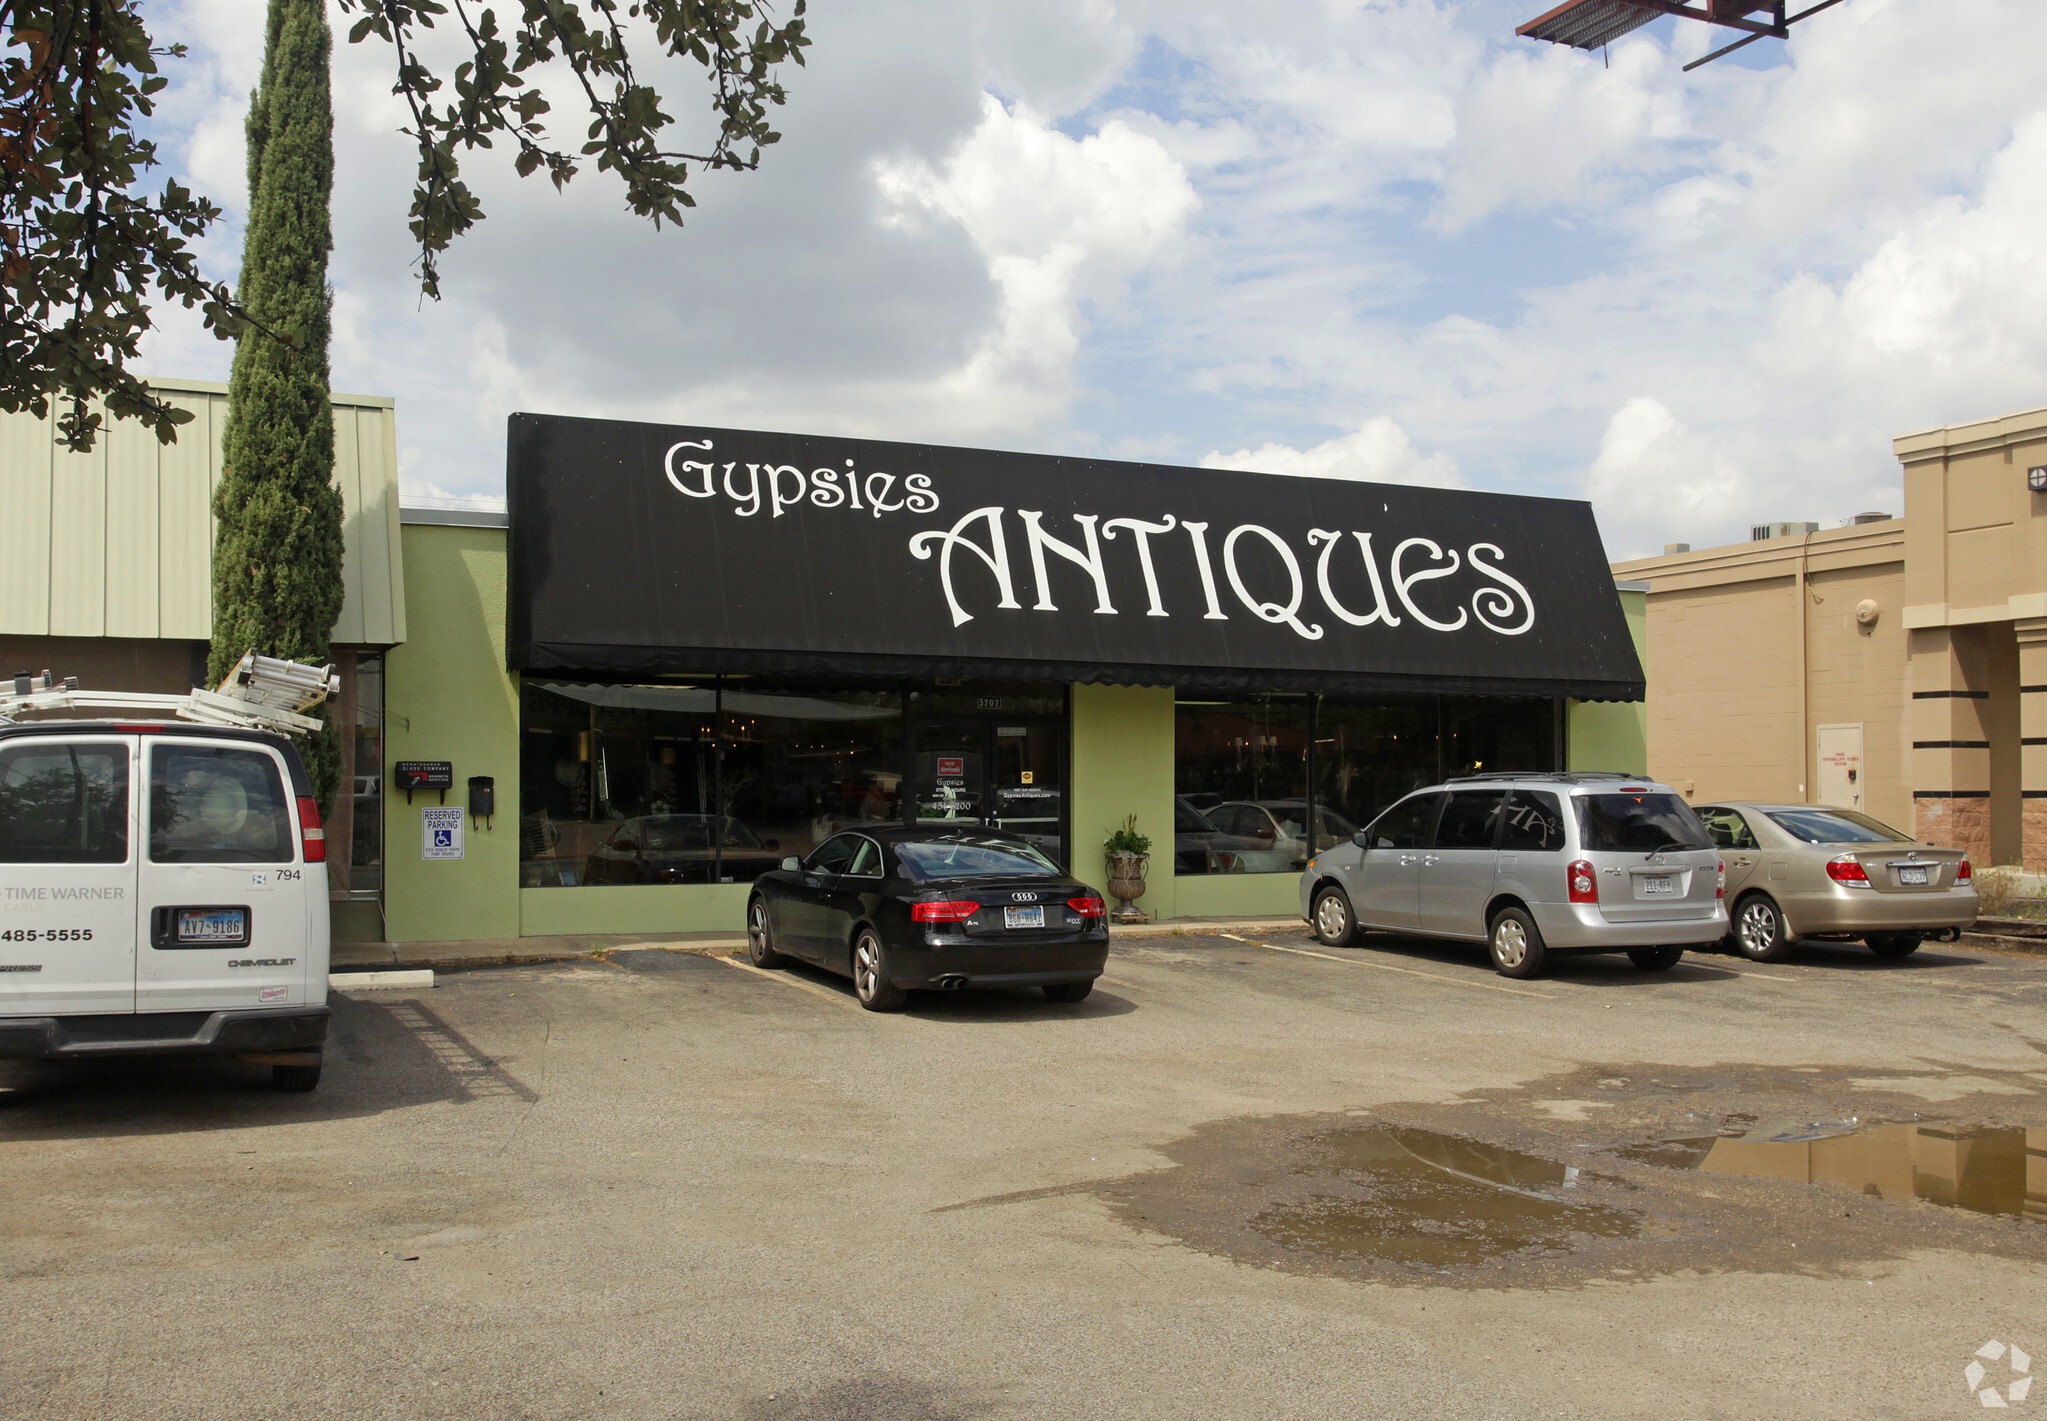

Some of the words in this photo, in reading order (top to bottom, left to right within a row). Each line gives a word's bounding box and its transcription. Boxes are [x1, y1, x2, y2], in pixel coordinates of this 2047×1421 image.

[665, 440, 939, 518] Gypsies
[909, 507, 1534, 640] ANTIQUES
[424, 810, 461, 820] RESERVED
[427, 820, 458, 829] PARKING
[276, 869, 301, 880] 794
[4, 887, 47, 900] TIME
[51, 887, 125, 900] WARNER
[1, 929, 93, 942] 485-5555
[228, 958, 296, 968] CHEVROLET
